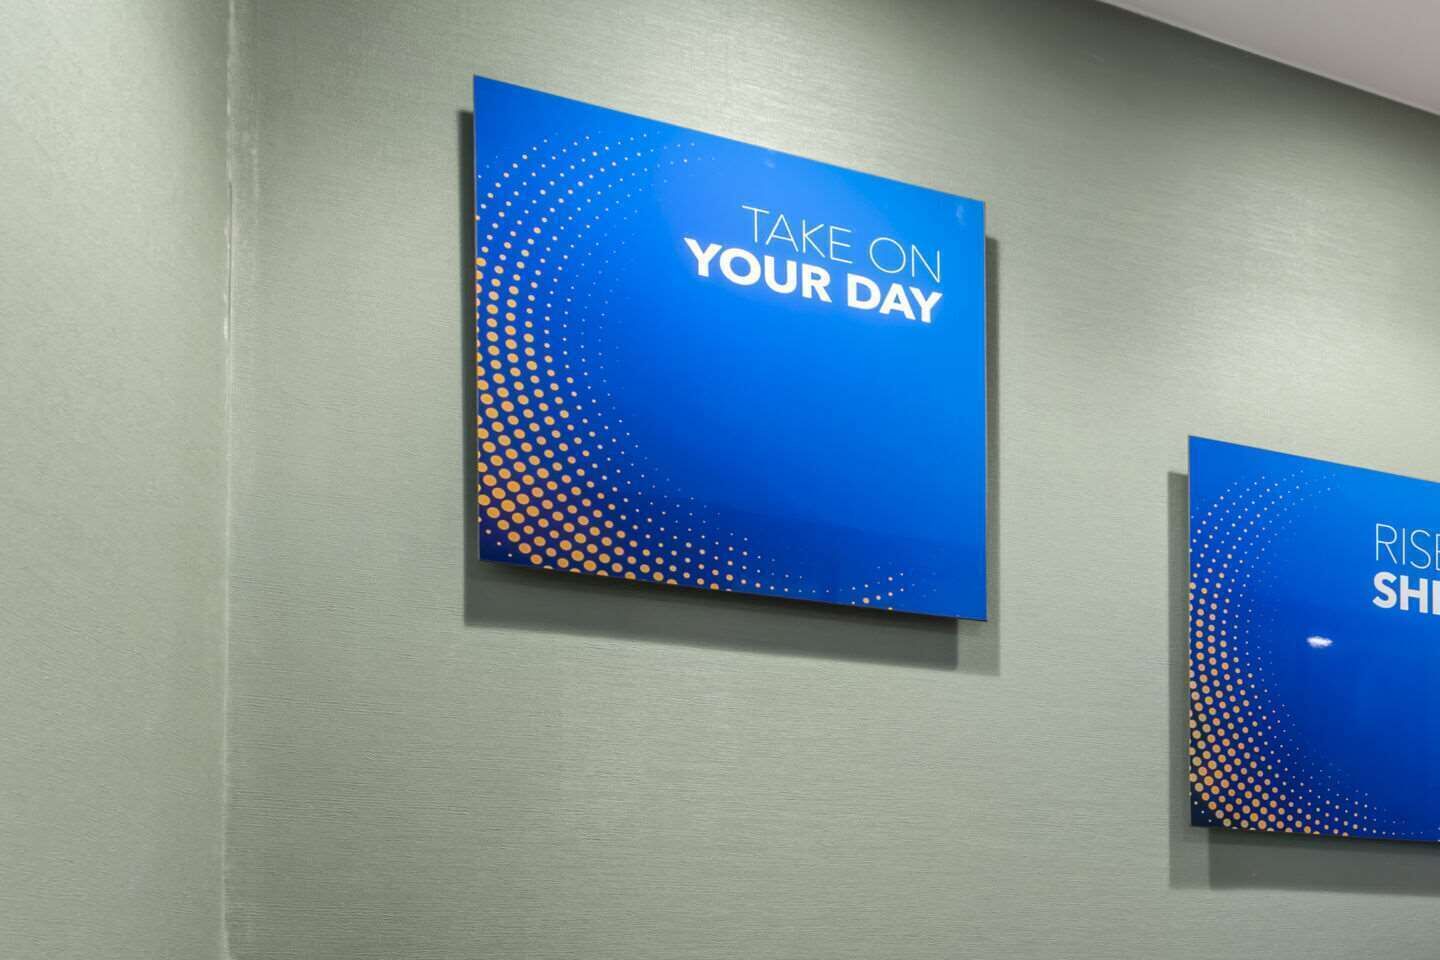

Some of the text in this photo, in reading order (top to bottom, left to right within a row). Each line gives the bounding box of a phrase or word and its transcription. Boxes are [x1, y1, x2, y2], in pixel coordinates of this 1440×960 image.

[683, 237, 944, 323] YOUR DAY
[742, 204, 941, 283] TAKE ON
